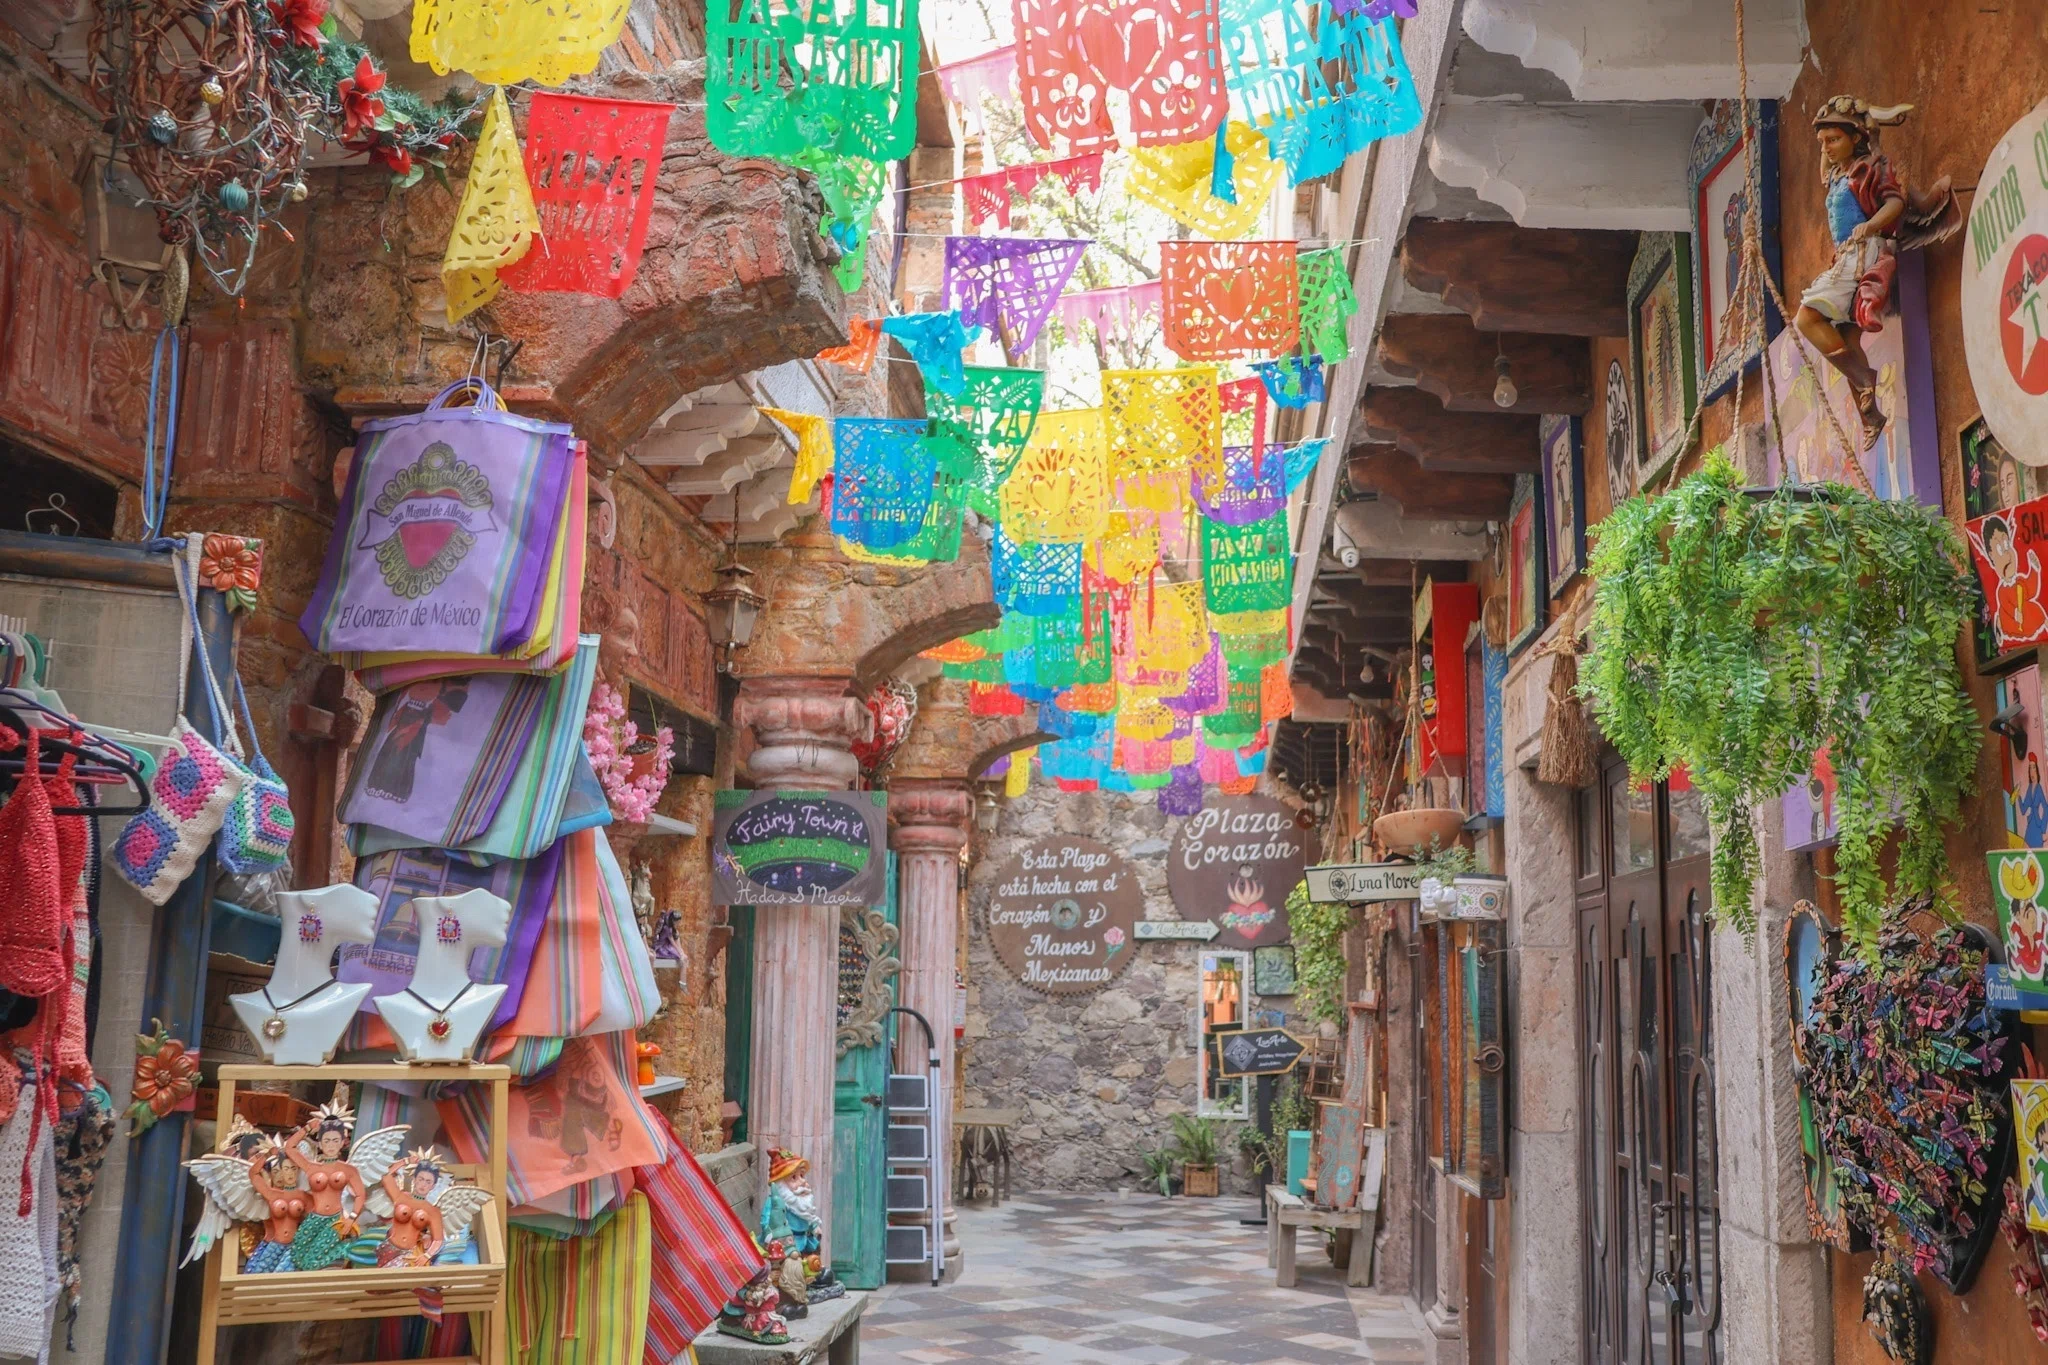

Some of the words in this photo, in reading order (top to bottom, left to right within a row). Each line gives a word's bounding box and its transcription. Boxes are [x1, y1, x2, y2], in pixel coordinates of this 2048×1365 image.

[1971, 164, 2026, 273] MOTOR
[2005, 252, 2048, 310] TEXACO
[388, 512, 404, 528] San
[405, 503, 432, 519] Miguel
[432, 504, 443, 517] de
[444, 503, 473, 526] Allende
[338, 603, 354, 629] El
[354, 602, 408, 628] Corazón
[410, 601, 428, 626] de
[431, 600, 481, 626] México
[737, 812, 795, 843] Fairy
[801, 805, 848, 835] Town
[1185, 807, 1293, 840] Plaza
[1020, 849, 1057, 871] Esta
[1060, 846, 1110, 873] Plaza
[1180, 833, 1300, 871] Corazón
[735, 879, 786, 905] Hadas
[810, 883, 862, 905] Magia
[999, 874, 1029, 898] está
[1031, 873, 1070, 896] hecha
[1075, 877, 1099, 894] con
[1103, 872, 1118, 891] el
[1349, 873, 1382, 892] Luna
[989, 899, 1051, 928] Corazón
[1084, 903, 1108, 928] y
[1024, 934, 1096, 957] Manos
[1021, 960, 1113, 988] Mexicanas
[1986, 978, 2018, 1001] Corona
